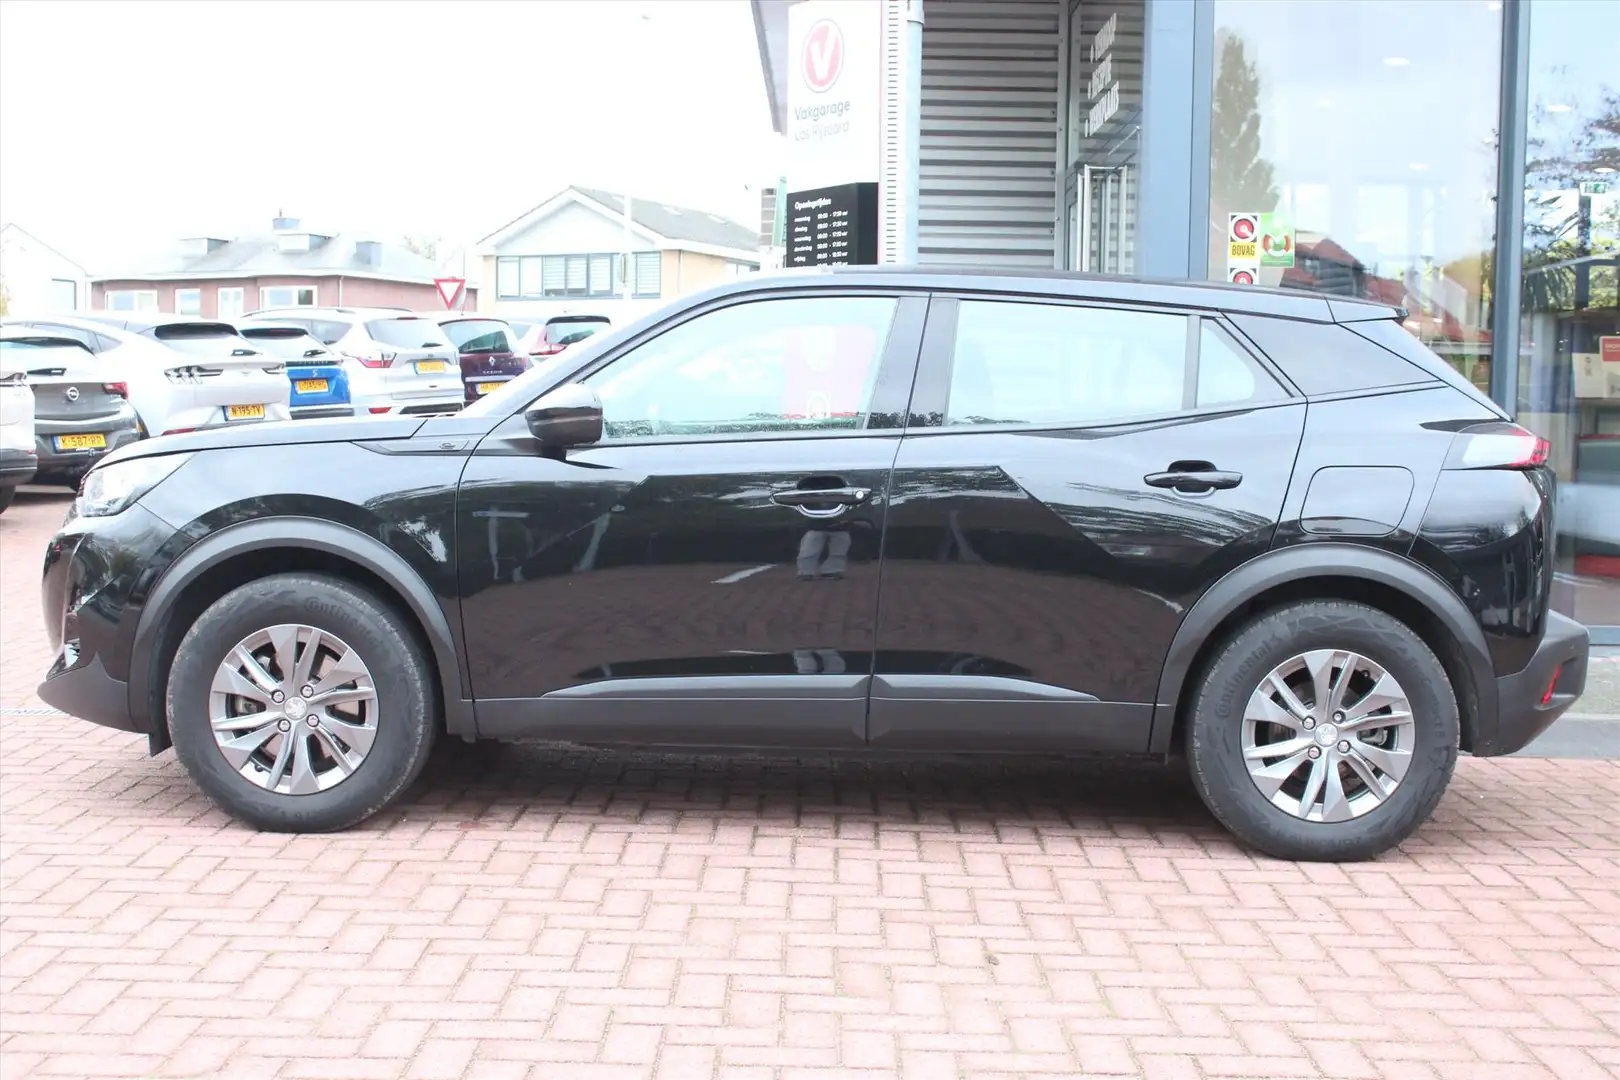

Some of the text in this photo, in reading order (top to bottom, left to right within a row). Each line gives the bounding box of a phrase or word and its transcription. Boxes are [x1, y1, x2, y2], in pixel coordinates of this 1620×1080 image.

[794, 100, 851, 122] Vakgarage
[1231, 244, 1255, 256] BOVAG
[1214, 640, 1271, 719] Continental
